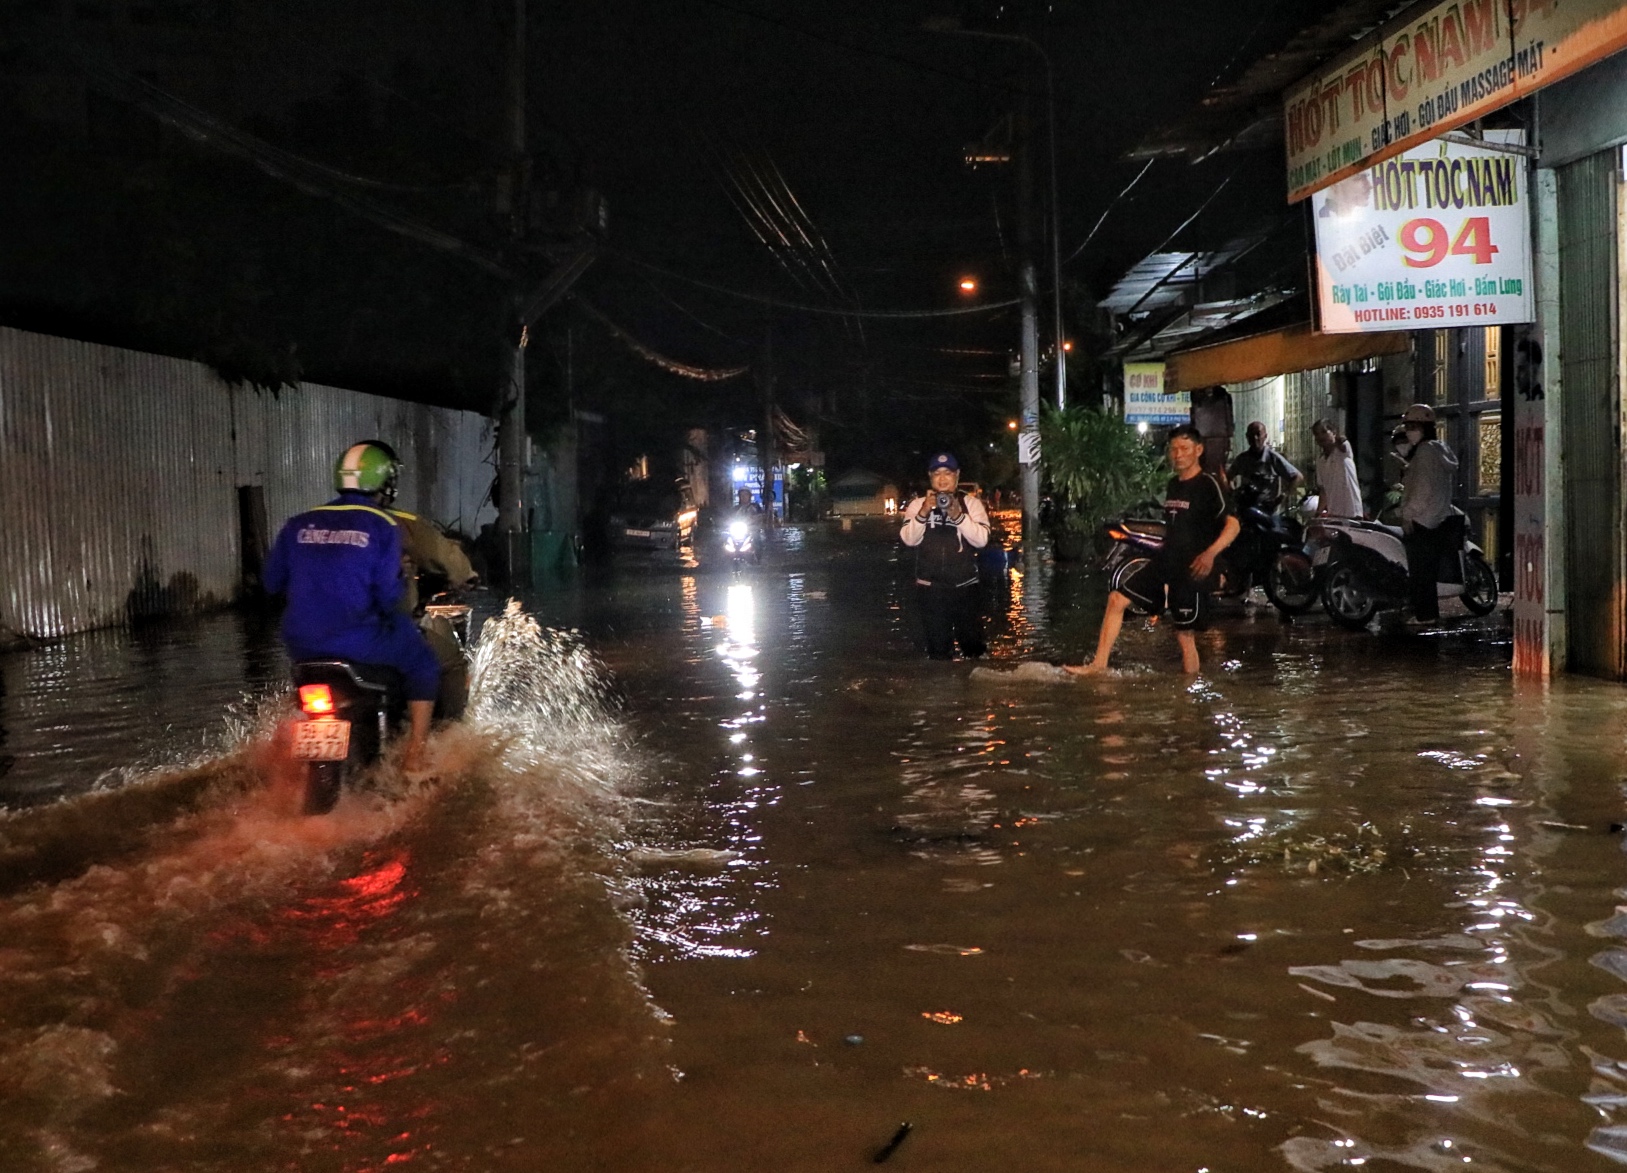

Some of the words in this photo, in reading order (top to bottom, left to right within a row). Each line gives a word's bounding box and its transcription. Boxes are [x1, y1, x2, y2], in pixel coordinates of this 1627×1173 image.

[1414, 0, 1499, 87] NAM
[1460, 57, 1515, 108] MASSAGE
[1517, 38, 1544, 79] MẶT
[1420, 142, 1467, 210] TÓC
[1467, 156, 1517, 207] NAM
[1398, 217, 1499, 268] 94
[1353, 283, 1368, 302] Tai
[1377, 281, 1394, 305] Gội
[1424, 279, 1447, 298] Giác
[1449, 279, 1466, 297] Hơi
[1475, 273, 1497, 296] Đấm
[1499, 276, 1522, 296] Lưng
[1354, 307, 1411, 322] HOTLINE:
[1413, 305, 1444, 319] 0935
[1448, 304, 1469, 317] 191
[1473, 303, 1497, 316] 614
